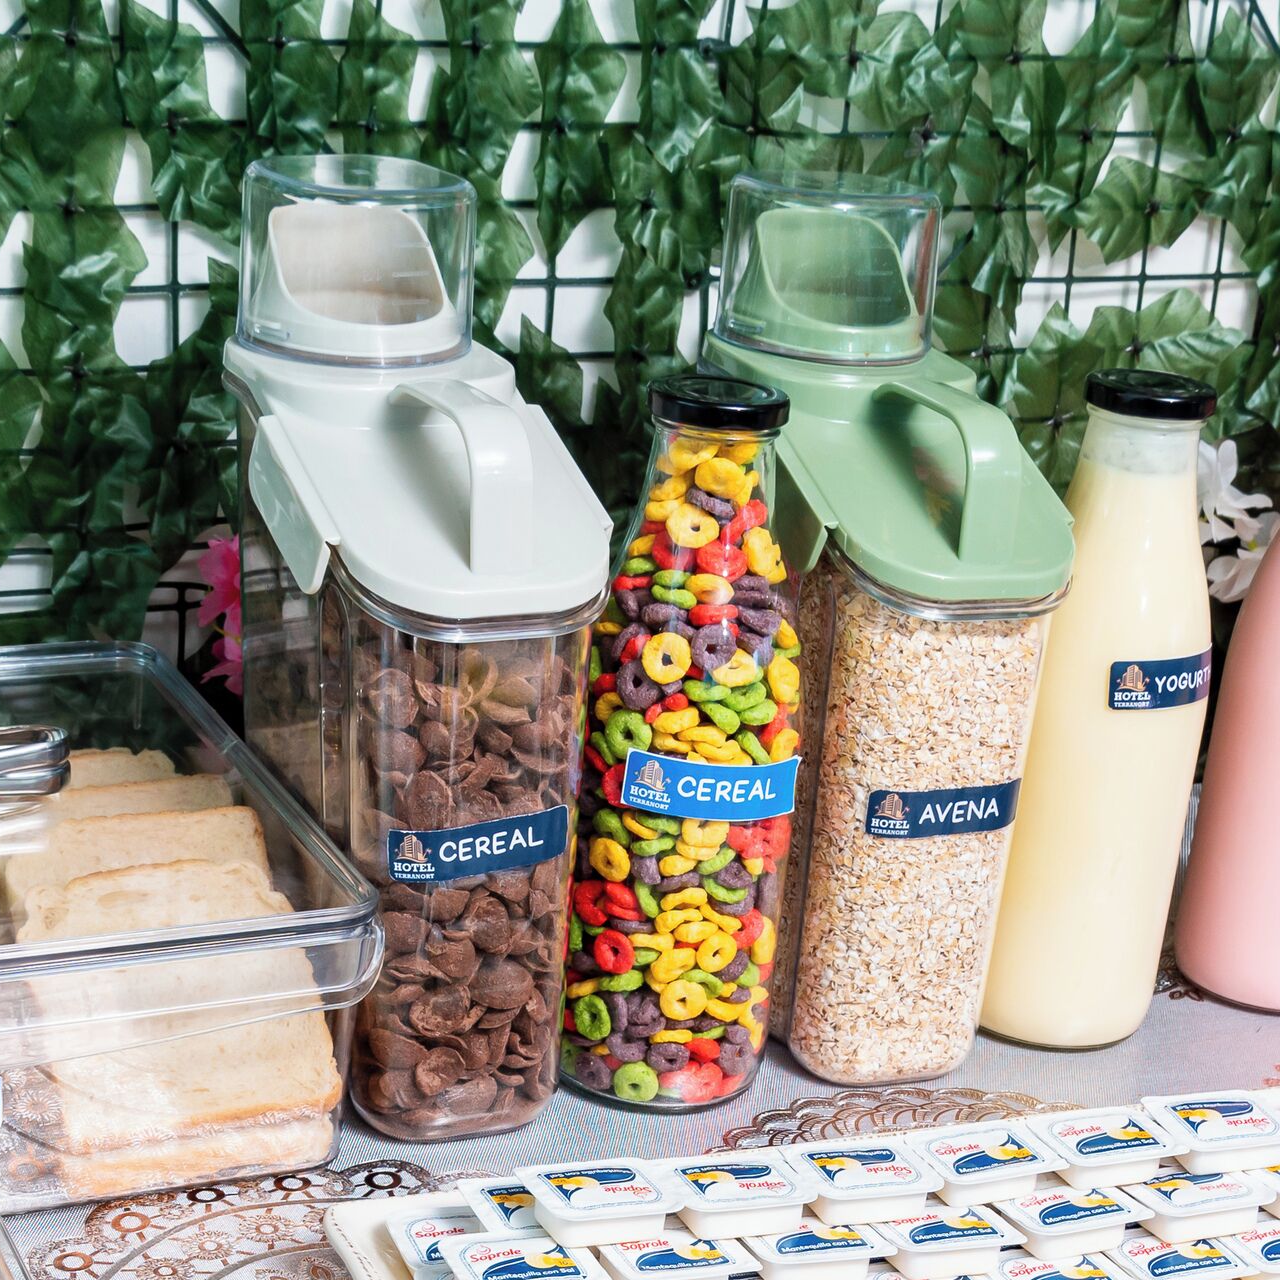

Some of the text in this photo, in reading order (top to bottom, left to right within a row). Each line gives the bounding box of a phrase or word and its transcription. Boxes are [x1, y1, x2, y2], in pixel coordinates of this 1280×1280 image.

[1114, 691, 1151, 700] HOTEL
[629, 785, 671, 803] HOTEL
[677, 776, 777, 803] CEREAL
[629, 796, 669, 811] TERRANORT
[918, 797, 999, 825] AVENA
[871, 818, 910, 829] HOTEL
[439, 826, 544, 862] CEREAL
[393, 862, 435, 872] HOTEL
[1226, 1117, 1270, 1127] Soprole
[1058, 1125, 1102, 1137] Soprole
[935, 1143, 980, 1156] Soprole
[867, 1164, 912, 1174] Soprole
[604, 1185, 652, 1194] Soprole
[739, 1180, 786, 1190] Soprole
[1020, 1194, 1064, 1208] Soprole
[891, 1214, 938, 1226] Soprole
[1045, 1210, 1091, 1224] Mantequilla
[415, 1227, 465, 1238] Soprole
[620, 1239, 669, 1250] Soprole
[781, 1243, 831, 1253] Mantequilla
[1128, 1243, 1173, 1257] Soprole
[470, 1249, 521, 1263] Soprole
[1009, 1263, 1054, 1277] Soprole
[1154, 1261, 1199, 1275] Mantequilla
